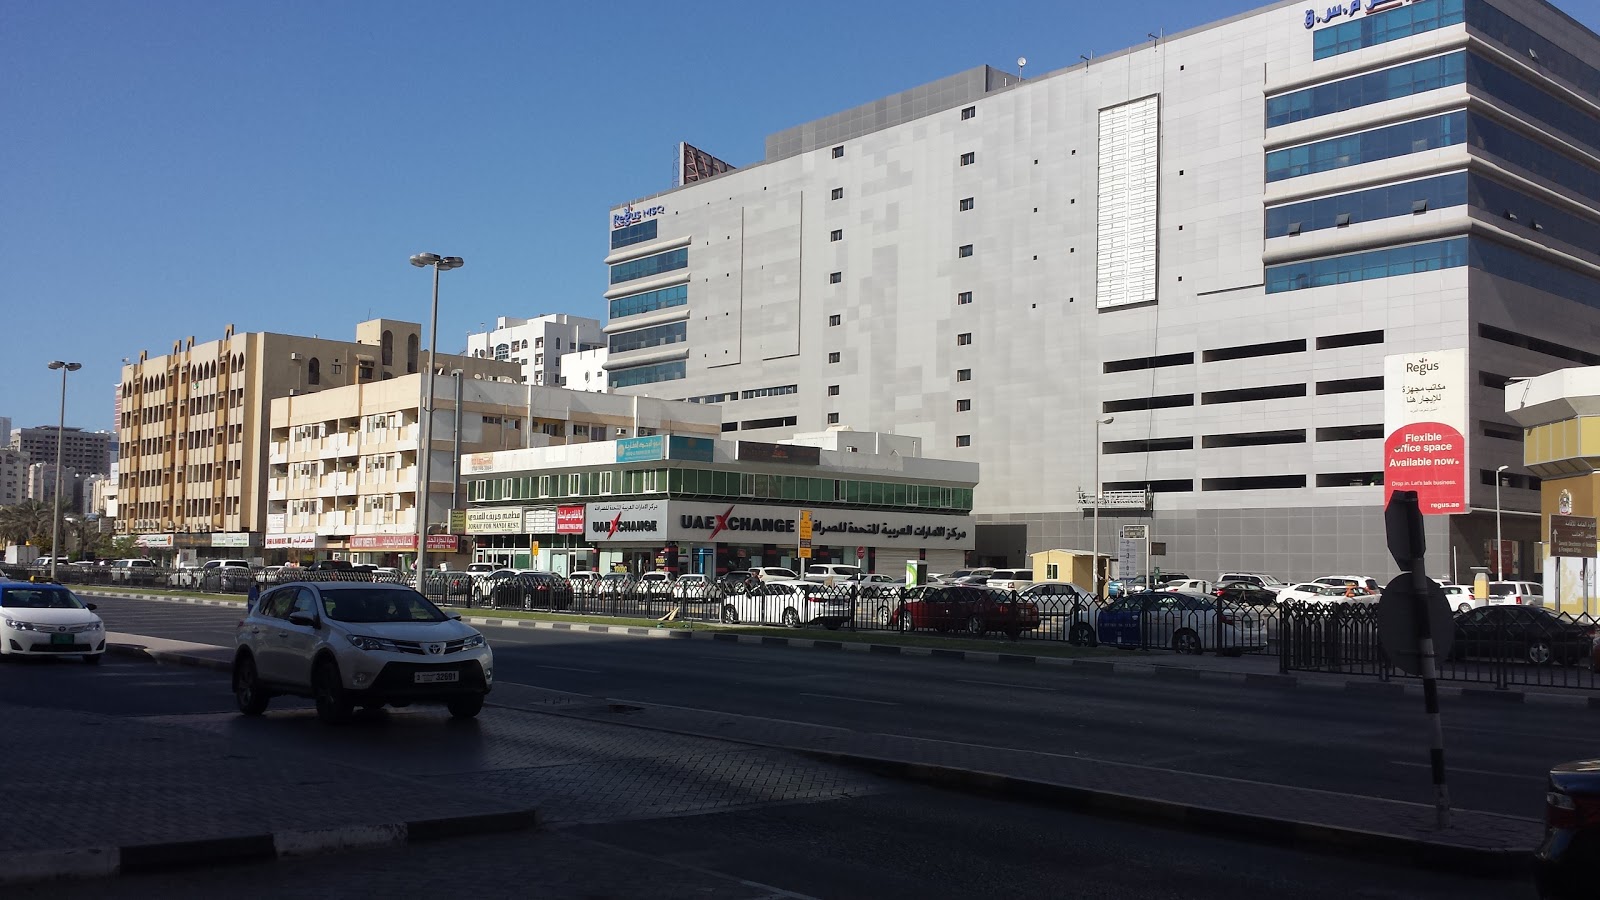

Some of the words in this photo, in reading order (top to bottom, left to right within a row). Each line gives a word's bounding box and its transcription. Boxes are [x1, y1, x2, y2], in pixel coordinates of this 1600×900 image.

[613, 209, 642, 227] Regus
[1406, 361, 1439, 375] Regus
[1402, 385, 1425, 395] مجهزة
[1425, 383, 1446, 393] مكاتب
[1406, 395, 1417, 404] هنا
[1405, 432, 1442, 443] Flexible
[1423, 443, 1453, 454] space
[1389, 457, 1432, 468] Available
[1391, 480, 1404, 488] Drop
[502, 511, 520, 520] مطعم
[812, 519, 847, 536] للصراف
[848, 522, 880, 535] المتحدة
[881, 522, 913, 538] العربية
[947, 526, 967, 541] مركز
